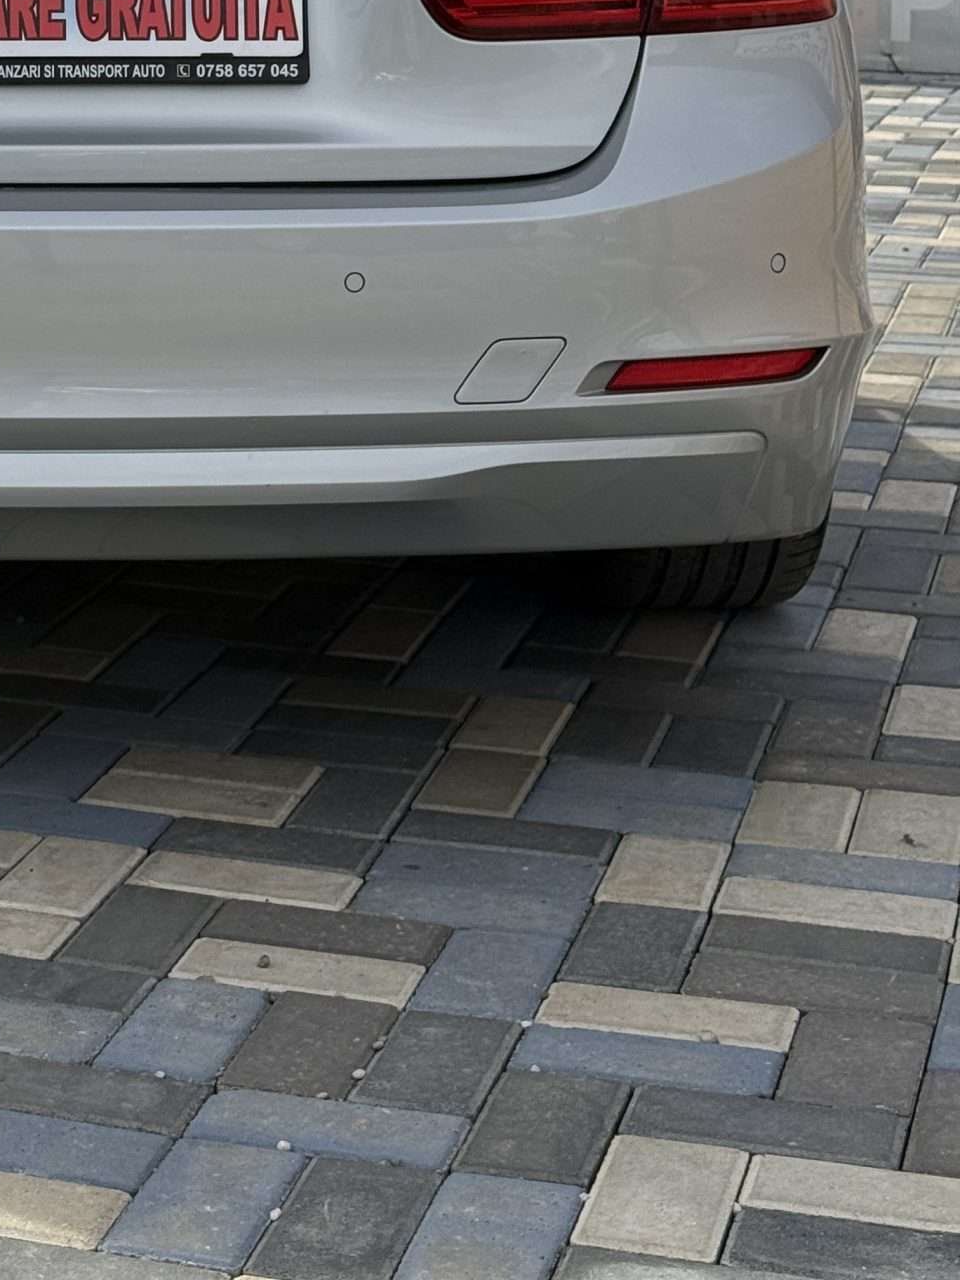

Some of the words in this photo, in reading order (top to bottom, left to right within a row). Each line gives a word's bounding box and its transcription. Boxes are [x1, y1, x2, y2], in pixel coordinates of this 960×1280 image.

[43, 64, 55, 78] SI
[57, 64, 130, 79] TRANSPORT
[132, 64, 166, 78] AUTO
[196, 63, 233, 78] 0758
[238, 63, 266, 78] 657
[270, 63, 299, 78] 045
